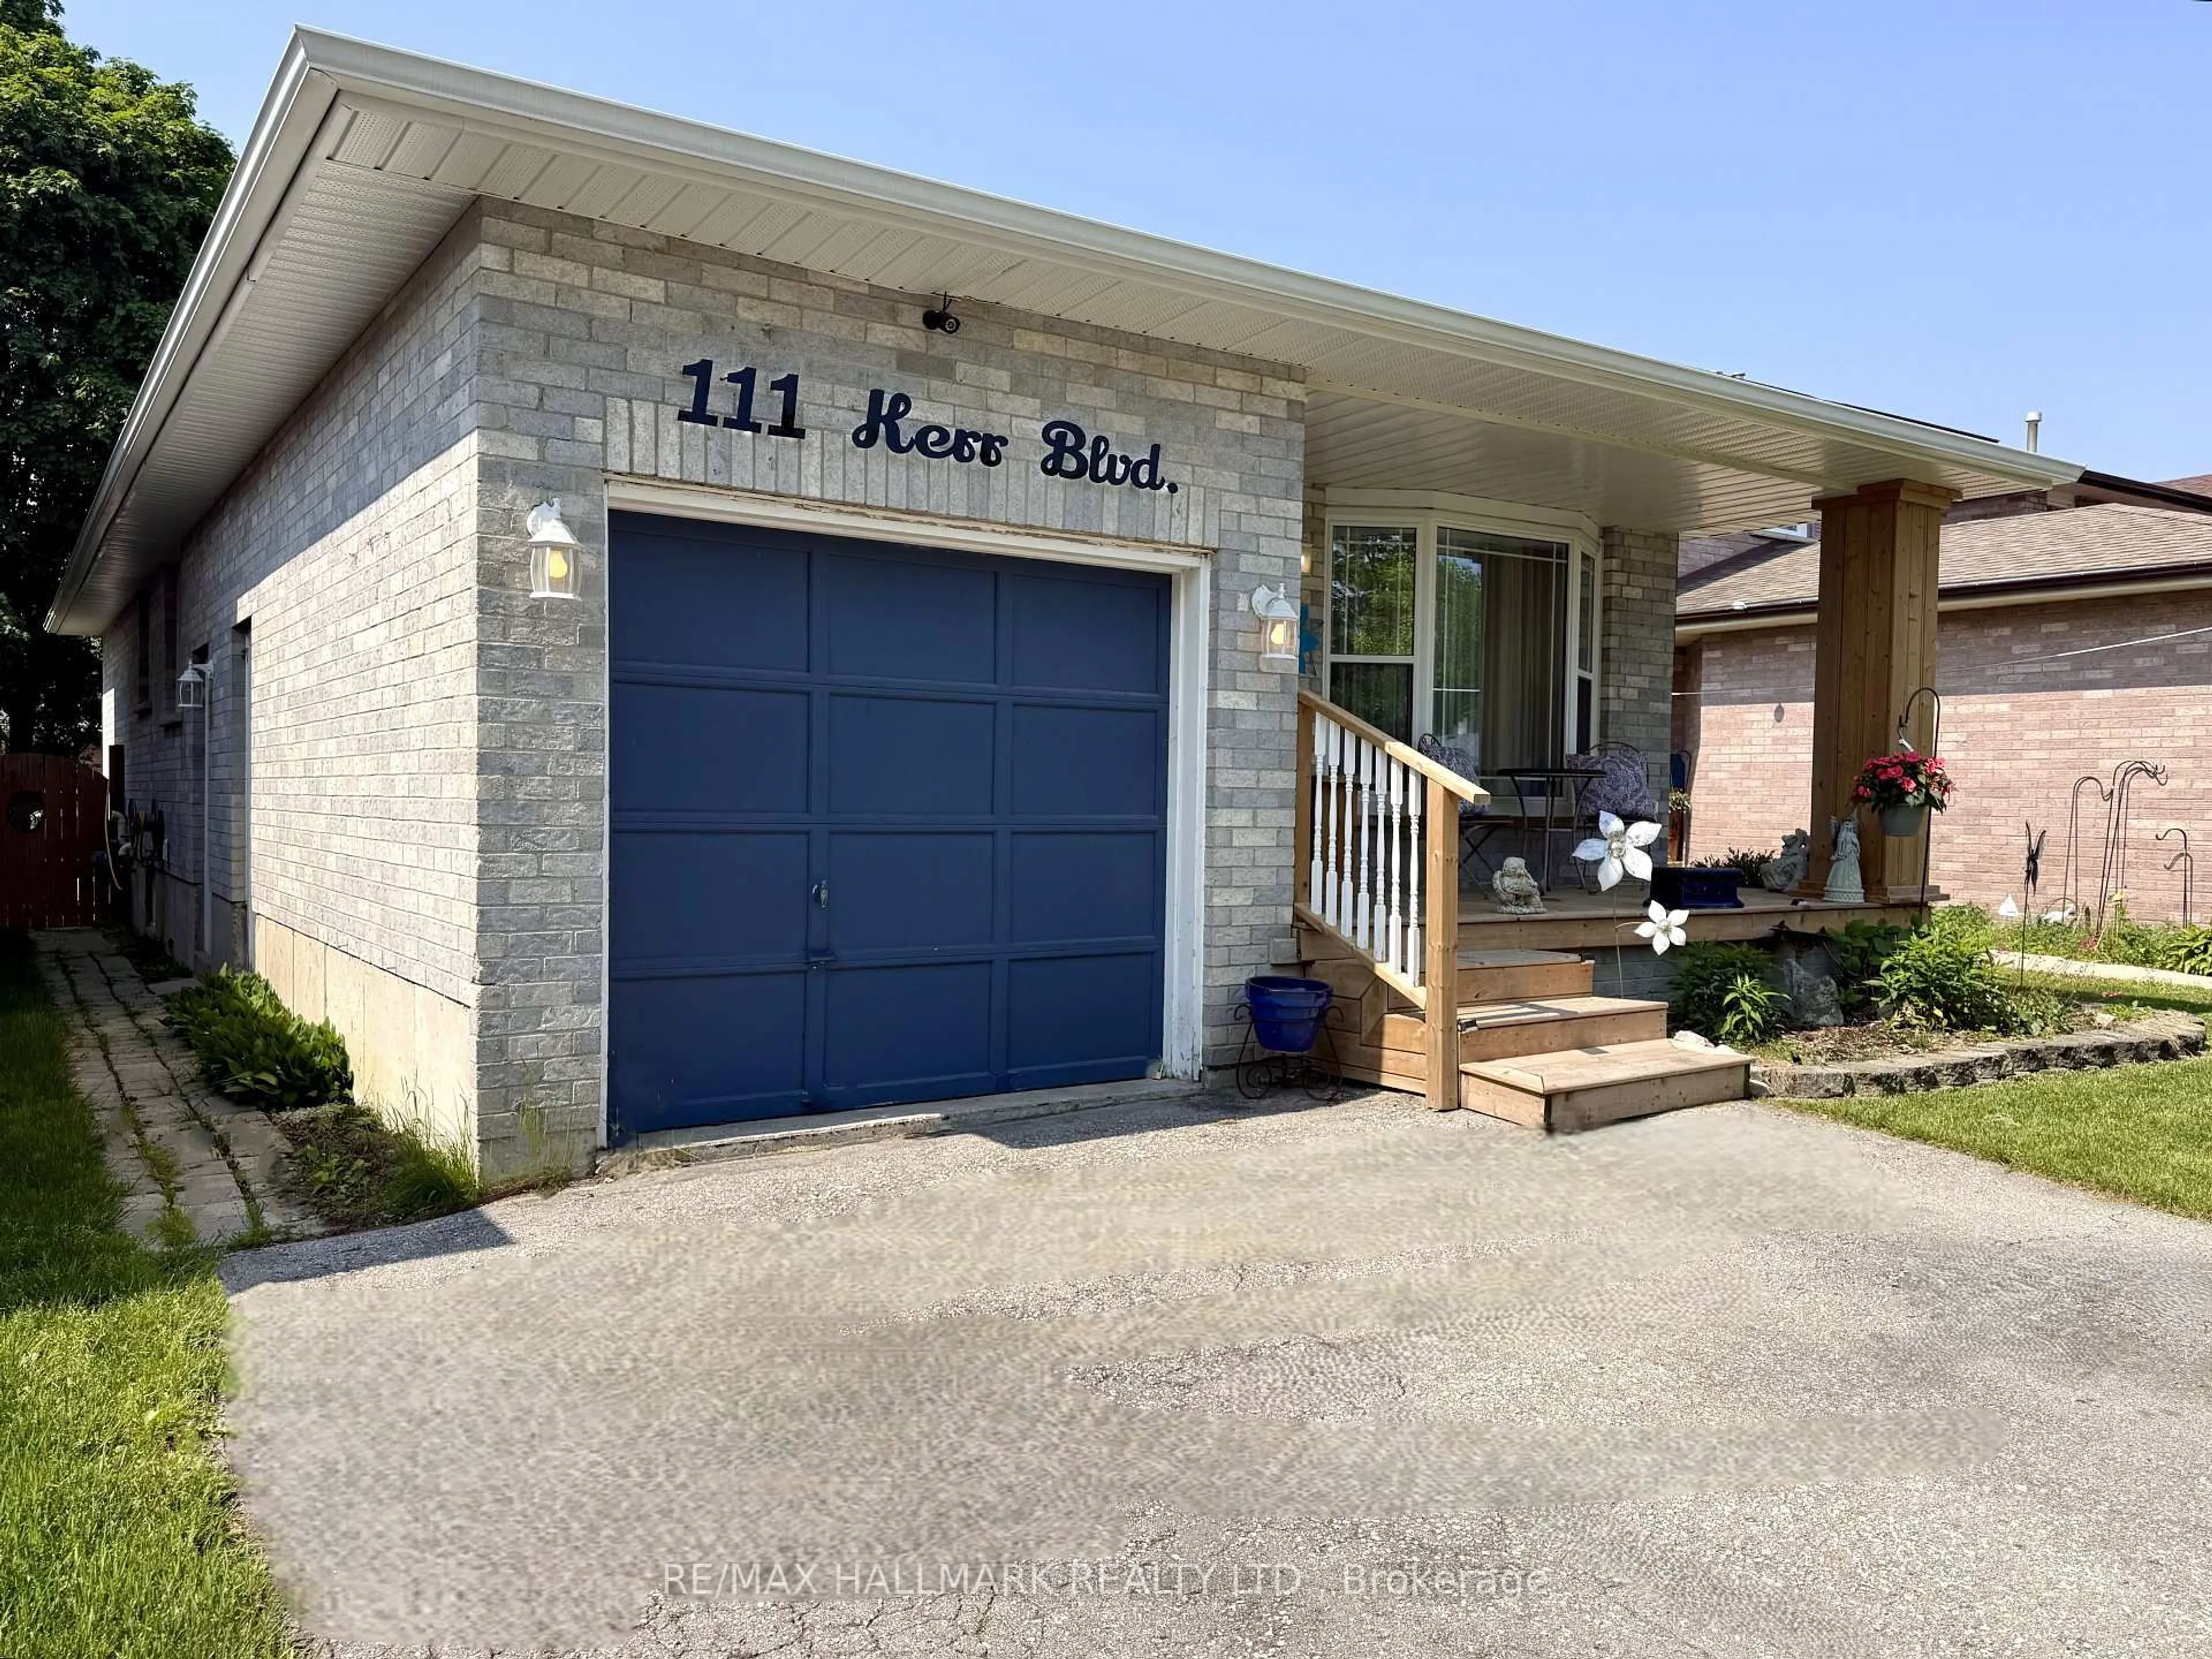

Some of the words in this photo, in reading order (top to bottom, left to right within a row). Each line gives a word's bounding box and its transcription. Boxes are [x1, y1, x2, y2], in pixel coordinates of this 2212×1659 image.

[677, 358, 806, 440] 111
[852, 389, 1008, 467] Kerr
[1041, 421, 1179, 494] Blvd.
